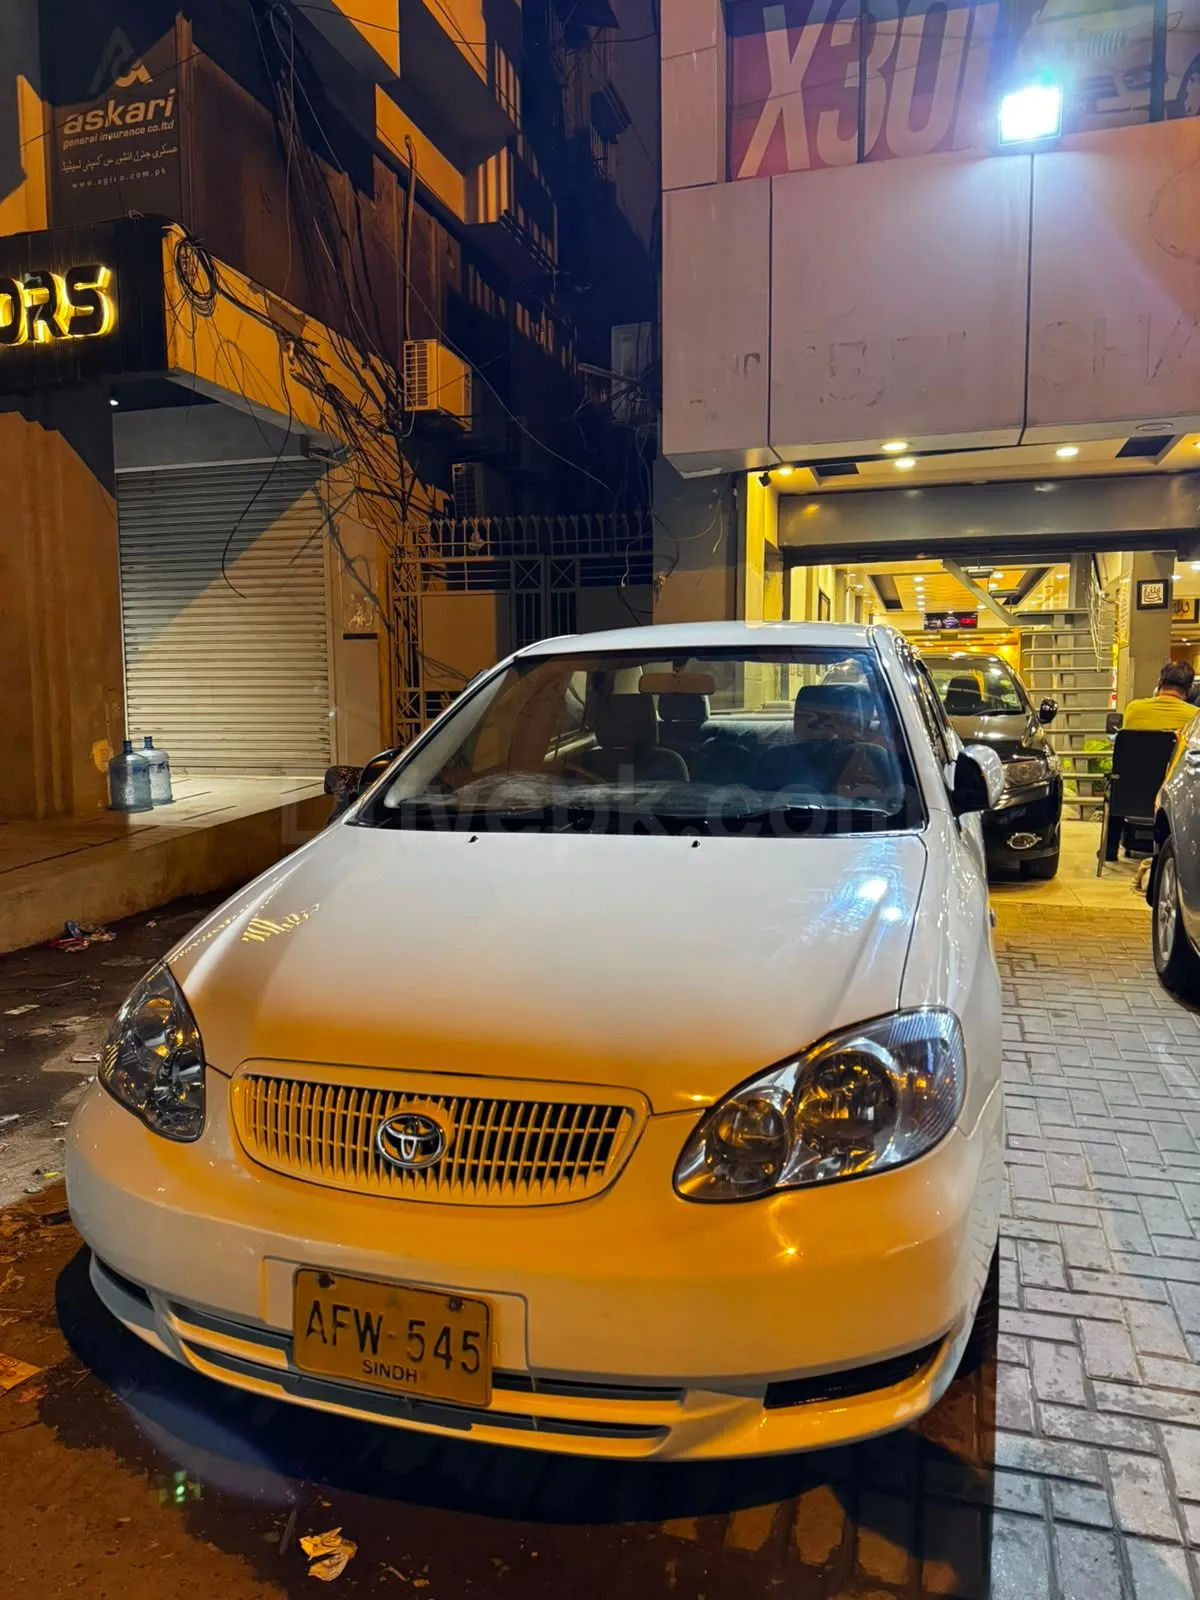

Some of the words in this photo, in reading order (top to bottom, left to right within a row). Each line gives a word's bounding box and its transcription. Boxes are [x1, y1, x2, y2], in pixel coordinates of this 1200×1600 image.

[63, 88, 176, 134] askari
[62, 132, 98, 150] general
[362, 1359, 418, 1384] SINDH
